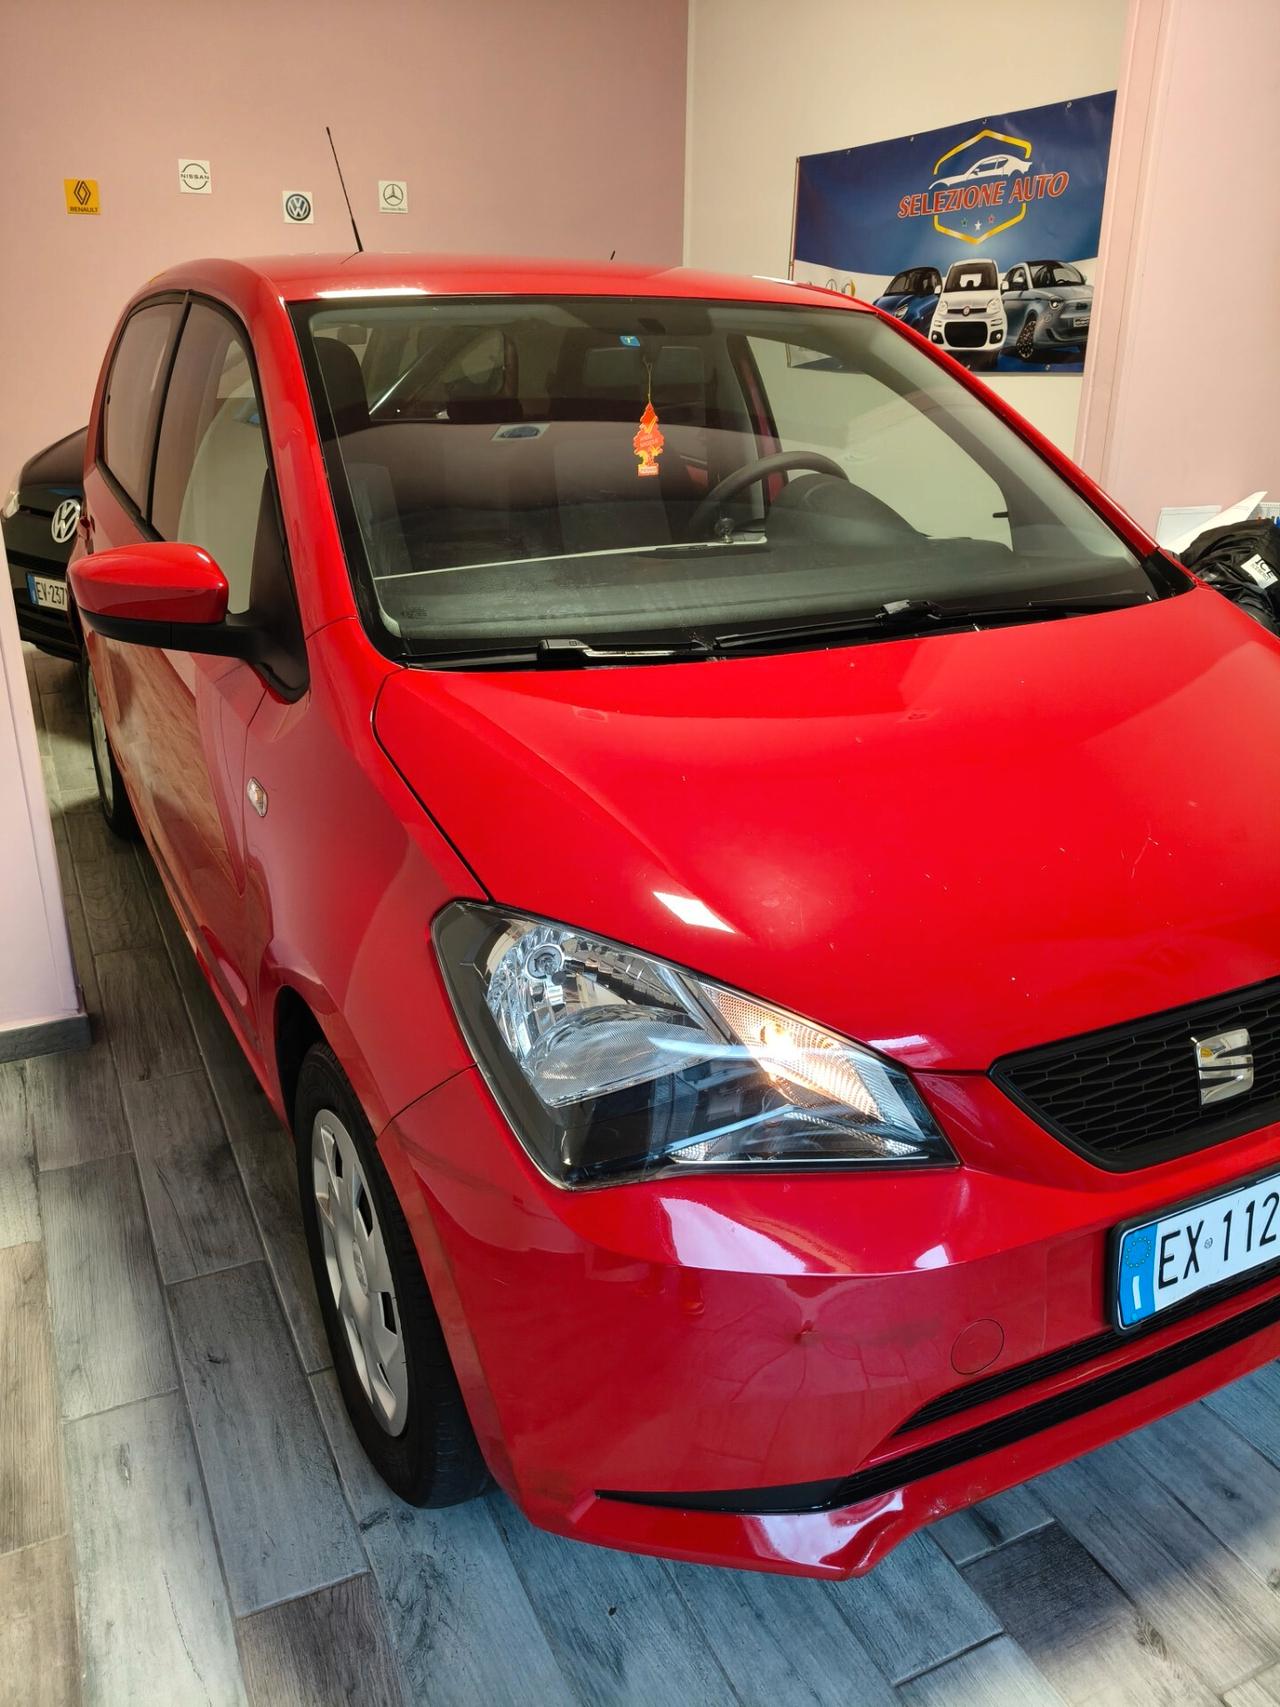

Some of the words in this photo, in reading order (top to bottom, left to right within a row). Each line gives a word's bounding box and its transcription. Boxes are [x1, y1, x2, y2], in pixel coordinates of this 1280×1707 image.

[897, 180, 1007, 219] SELEZIONE
[1008, 170, 1070, 203] AUTO
[49, 584, 68, 606] 237
[1158, 1220, 1204, 1290] EX
[1223, 1192, 1280, 1262] 112
